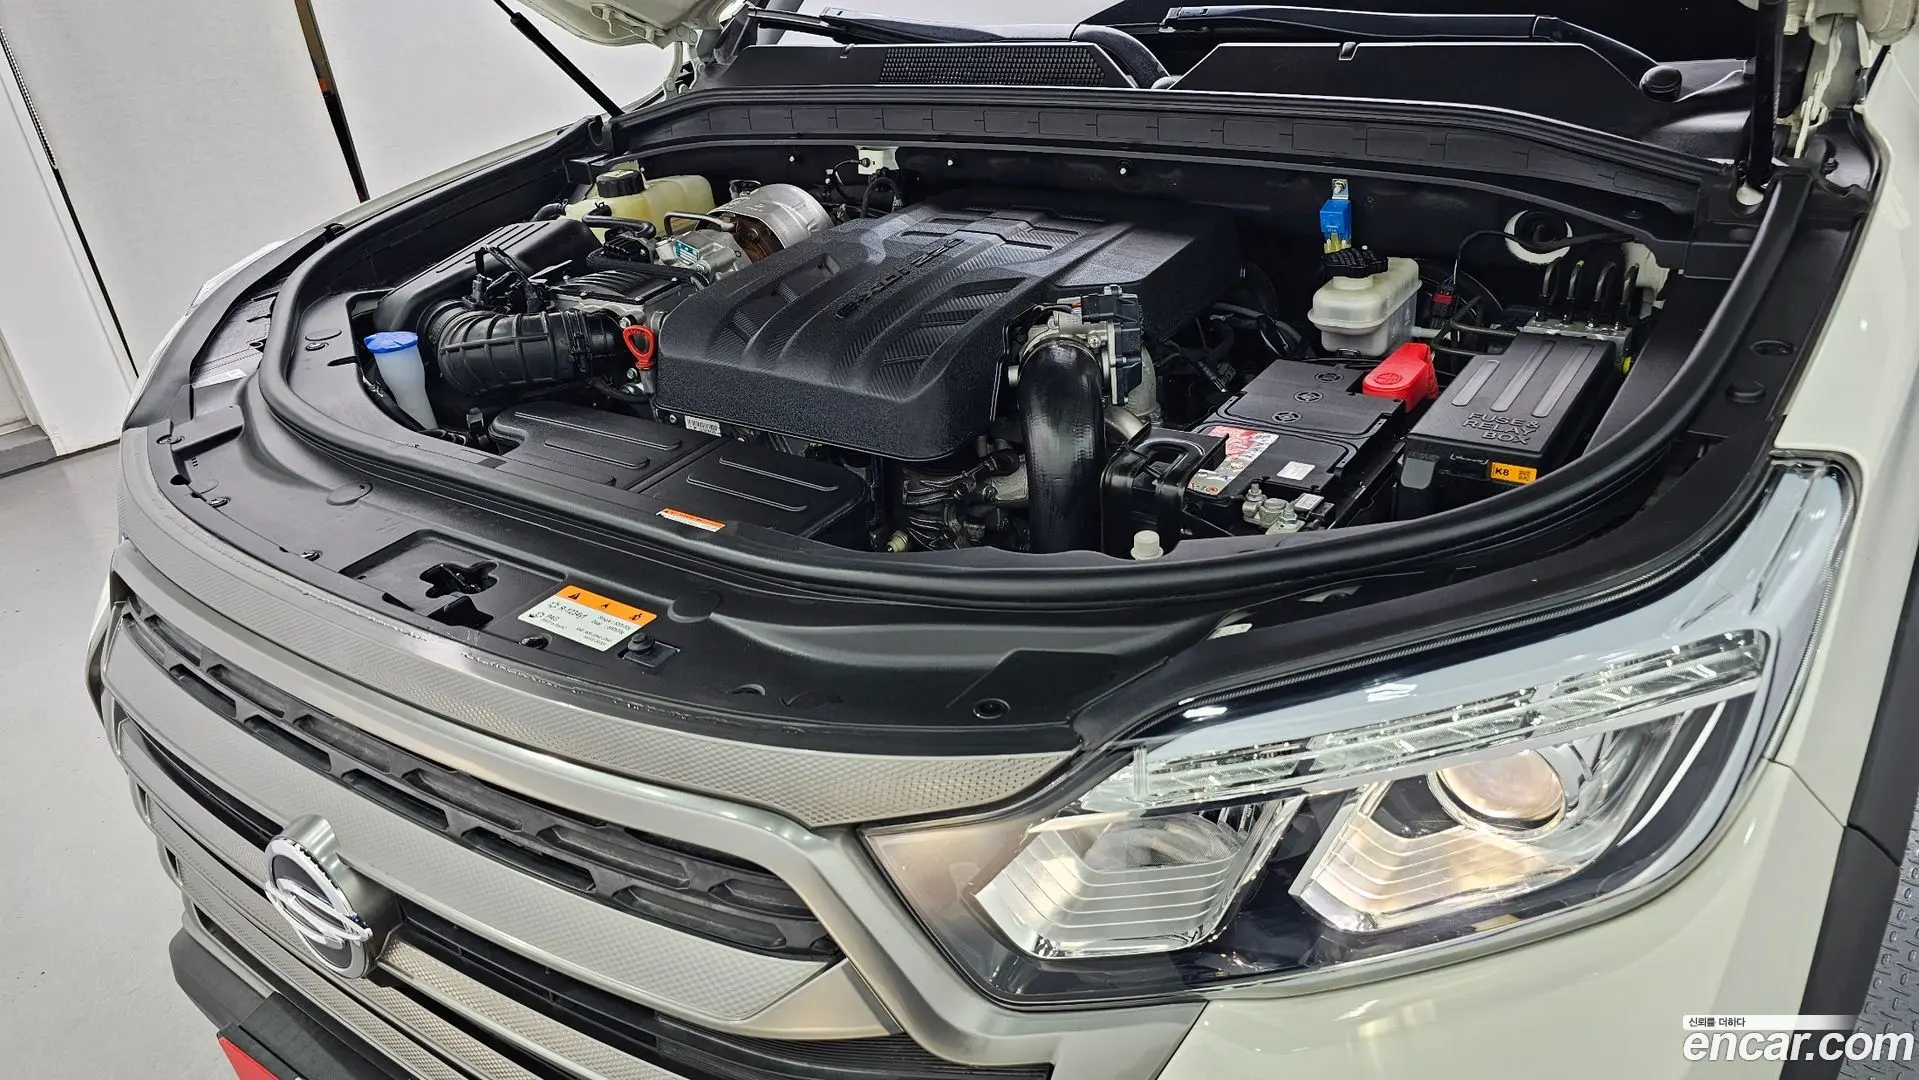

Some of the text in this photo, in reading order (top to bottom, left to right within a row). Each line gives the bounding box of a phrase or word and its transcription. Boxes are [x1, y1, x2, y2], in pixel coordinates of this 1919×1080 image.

[1462, 419, 1537, 436] RELAY
[1468, 412, 1540, 429] FUSE &
[1481, 431, 1531, 445] BOX
[1495, 467, 1510, 476] K8
